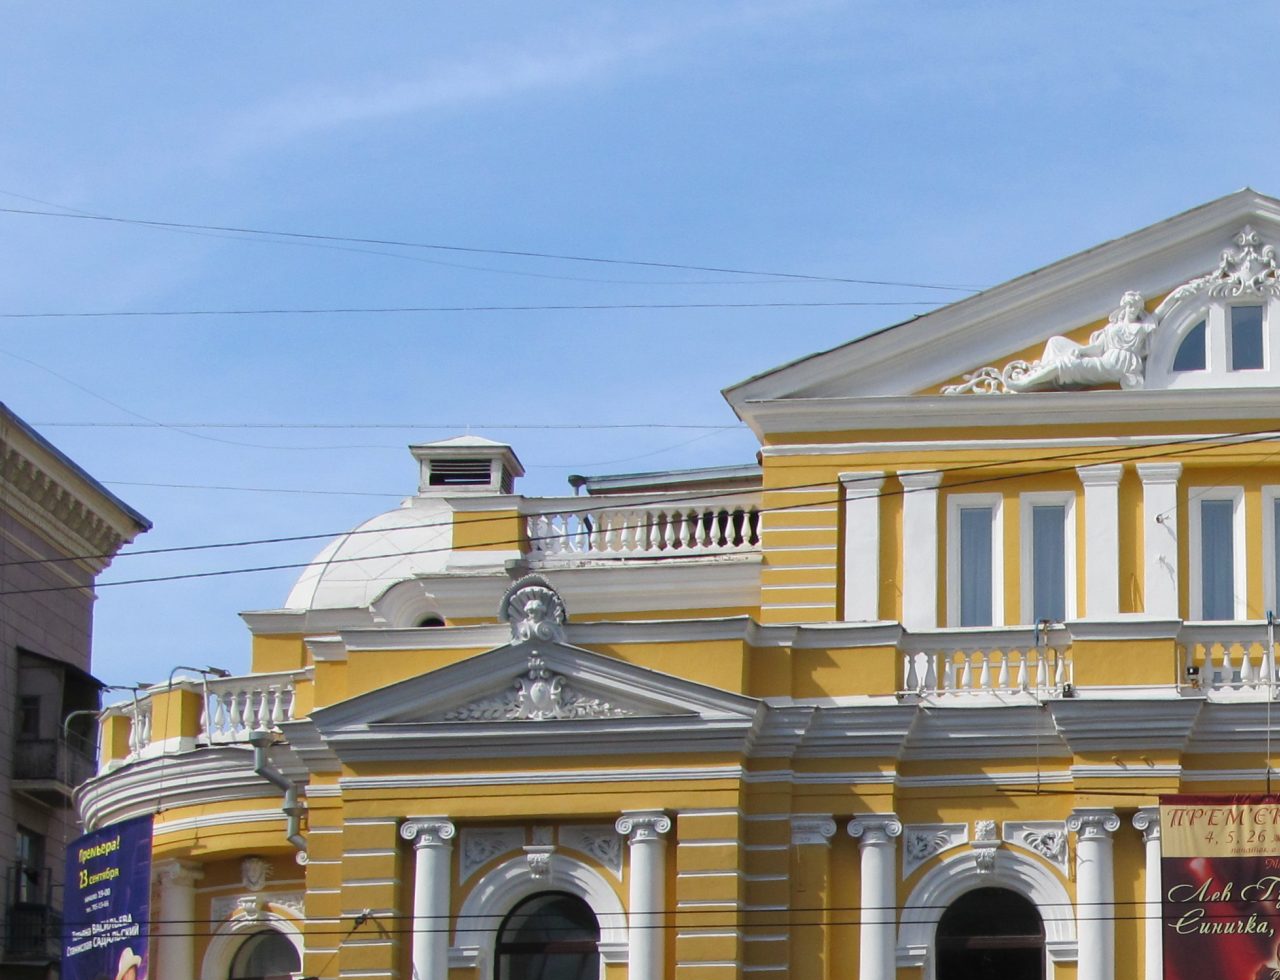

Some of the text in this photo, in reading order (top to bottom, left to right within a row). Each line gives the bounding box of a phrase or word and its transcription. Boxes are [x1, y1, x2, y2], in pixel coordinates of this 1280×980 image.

[1246, 830, 1266, 843] 26
[79, 835, 120, 864] Премьера!
[79, 868, 88, 889] 23
[1167, 877, 1233, 903] Лев
